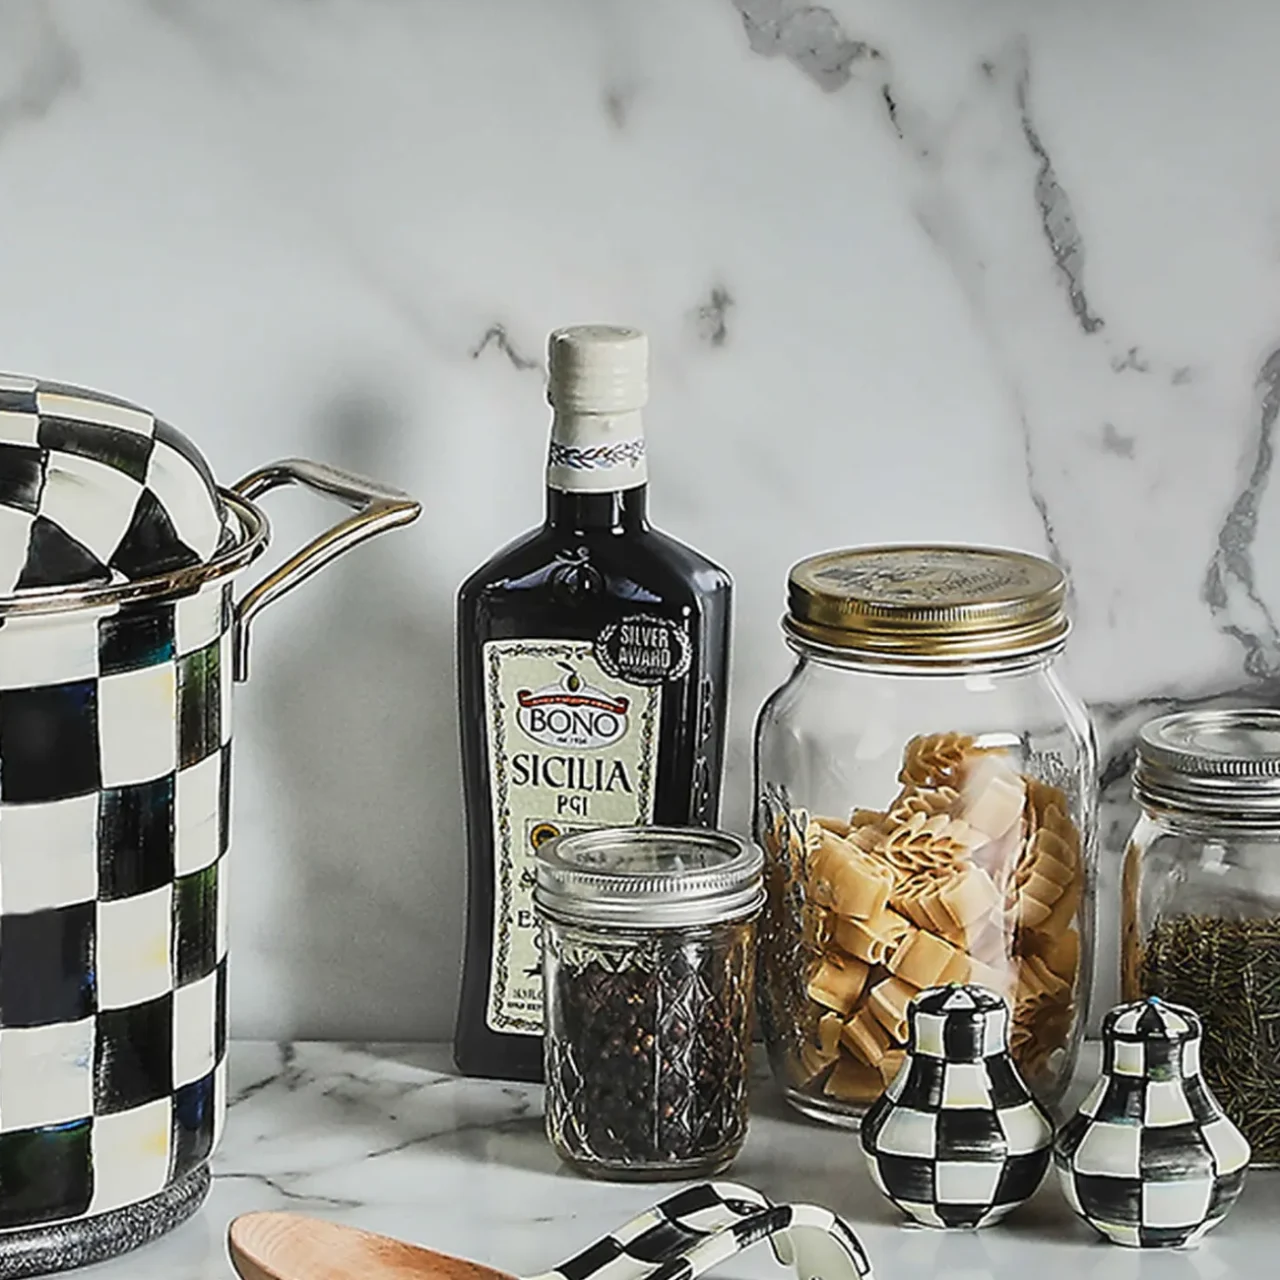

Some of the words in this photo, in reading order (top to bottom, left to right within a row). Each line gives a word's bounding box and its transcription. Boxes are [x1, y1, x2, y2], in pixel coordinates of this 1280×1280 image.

[620, 624, 669, 649] SILVER
[618, 646, 671, 668] AWARD
[530, 708, 619, 738] BONO
[511, 753, 633, 793] SICILIA
[556, 794, 588, 817] PGI
